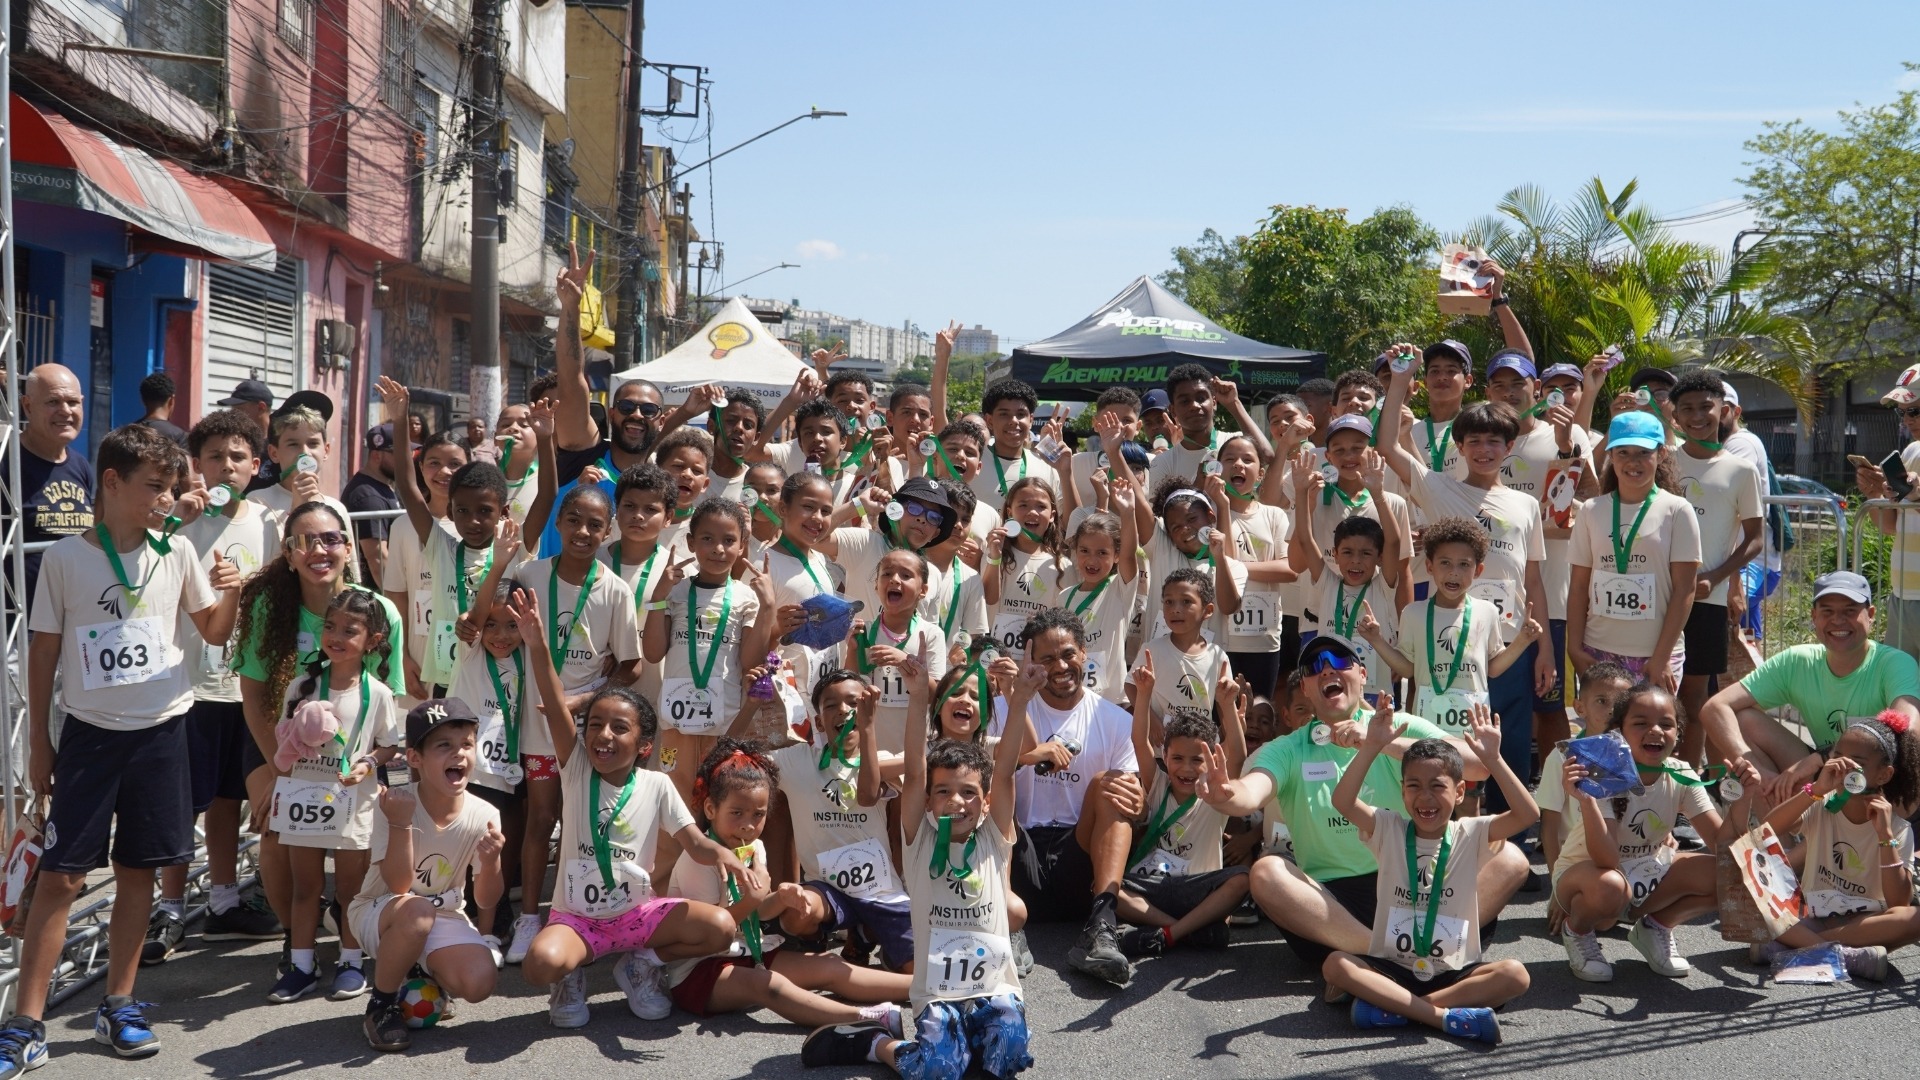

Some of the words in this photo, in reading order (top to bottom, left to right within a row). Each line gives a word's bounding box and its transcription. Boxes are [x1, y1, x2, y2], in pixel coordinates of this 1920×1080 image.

[1097, 306, 1206, 333] ADEMIR
[1121, 326, 1222, 341] PAULINO
[1041, 356, 1123, 384] ADEMIR
[1123, 366, 1169, 383] PAUL
[1251, 370, 1299, 379] ASSESSORIA
[1251, 377, 1300, 386] ESPORTIVA
[43, 480, 86, 504] COSTA
[1605, 591, 1640, 610] 148
[1233, 609, 1264, 626] 011
[99, 643, 149, 672] 063
[882, 676, 911, 695] 11
[288, 802, 335, 824] 059
[813, 811, 868, 823] INSTITUTO
[836, 862, 875, 889] 082
[1818, 864, 1866, 895] INSTITUTO
[584, 881, 631, 905] 04
[1394, 885, 1454, 902] INSTITTO
[929, 901, 993, 920] INSTITUTO
[935, 919, 962, 927] ADEMIR
[1396, 933, 1444, 958] 06
[942, 956, 988, 982] 116
